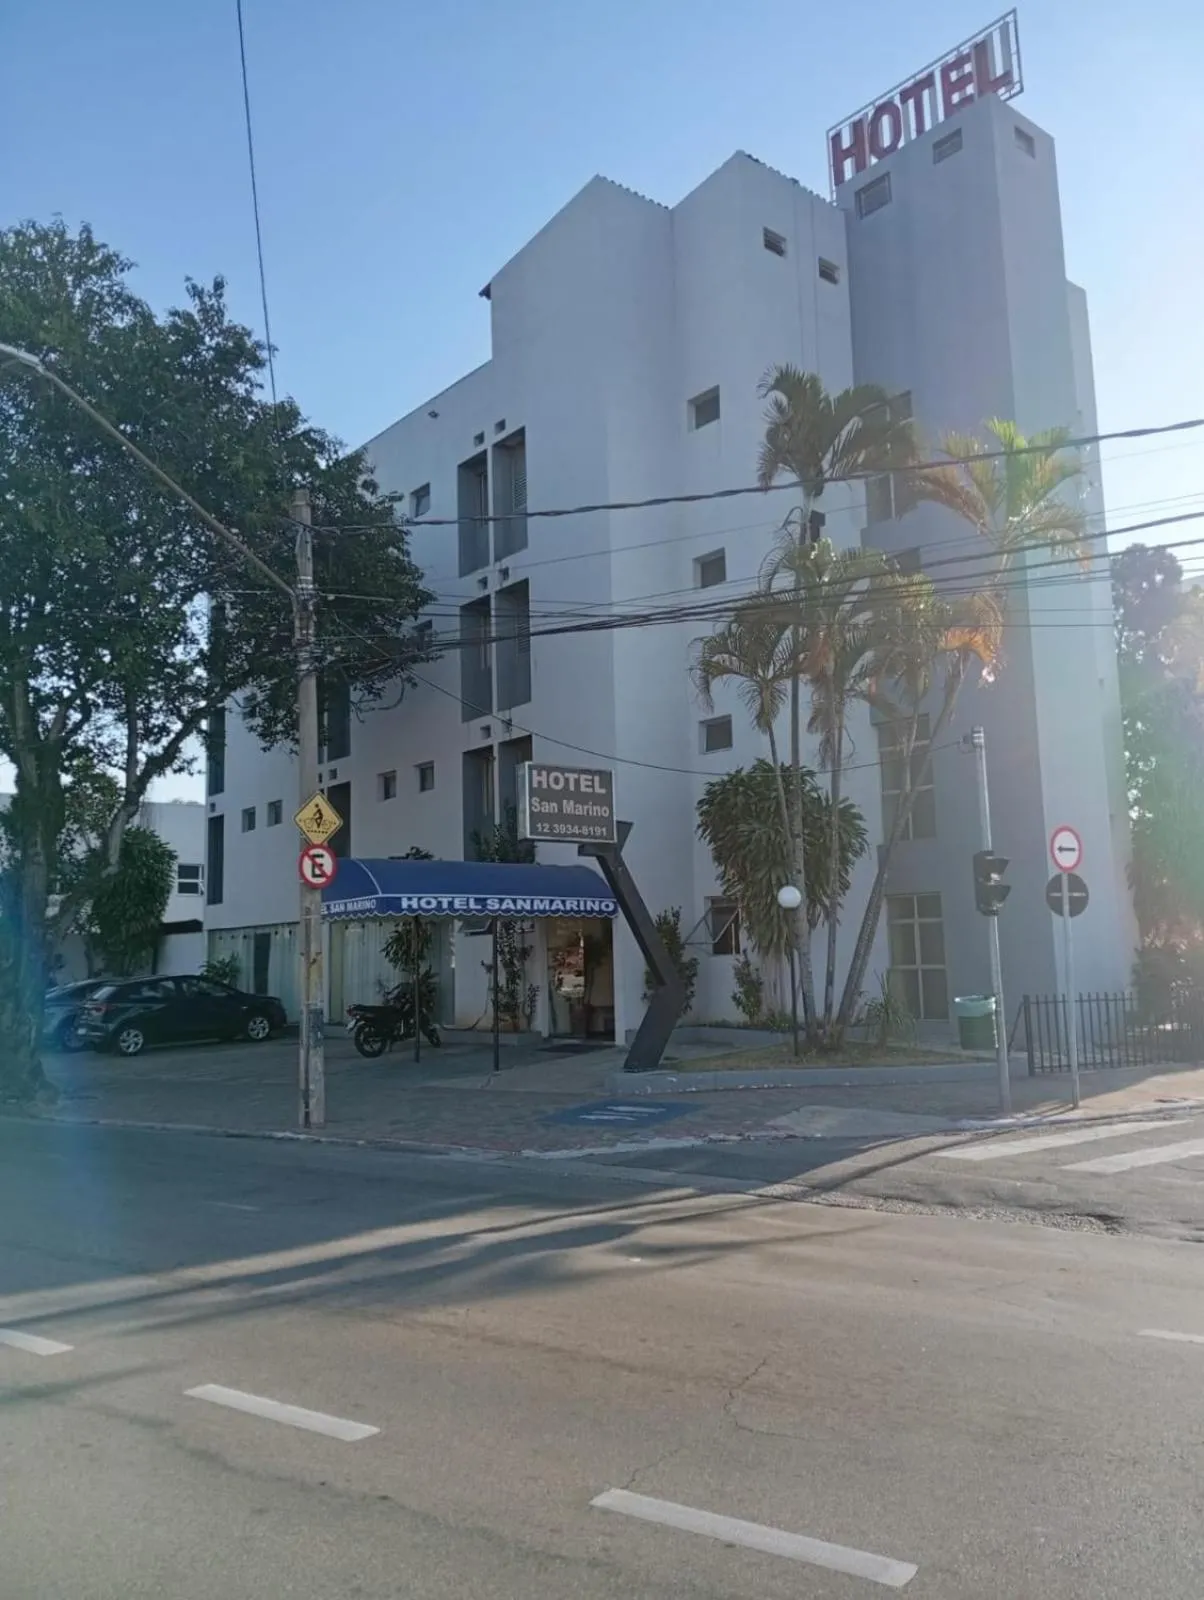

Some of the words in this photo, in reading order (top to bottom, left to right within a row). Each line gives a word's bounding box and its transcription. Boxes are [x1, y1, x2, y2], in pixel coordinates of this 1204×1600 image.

[831, 36, 1013, 187] HOTEL
[532, 769, 606, 794] HOTEL
[531, 797, 558, 814] San
[562, 799, 610, 818] Marino
[329, 902, 345, 914] SAN
[346, 898, 377, 912] MARINO
[401, 896, 482, 910] HOTEL
